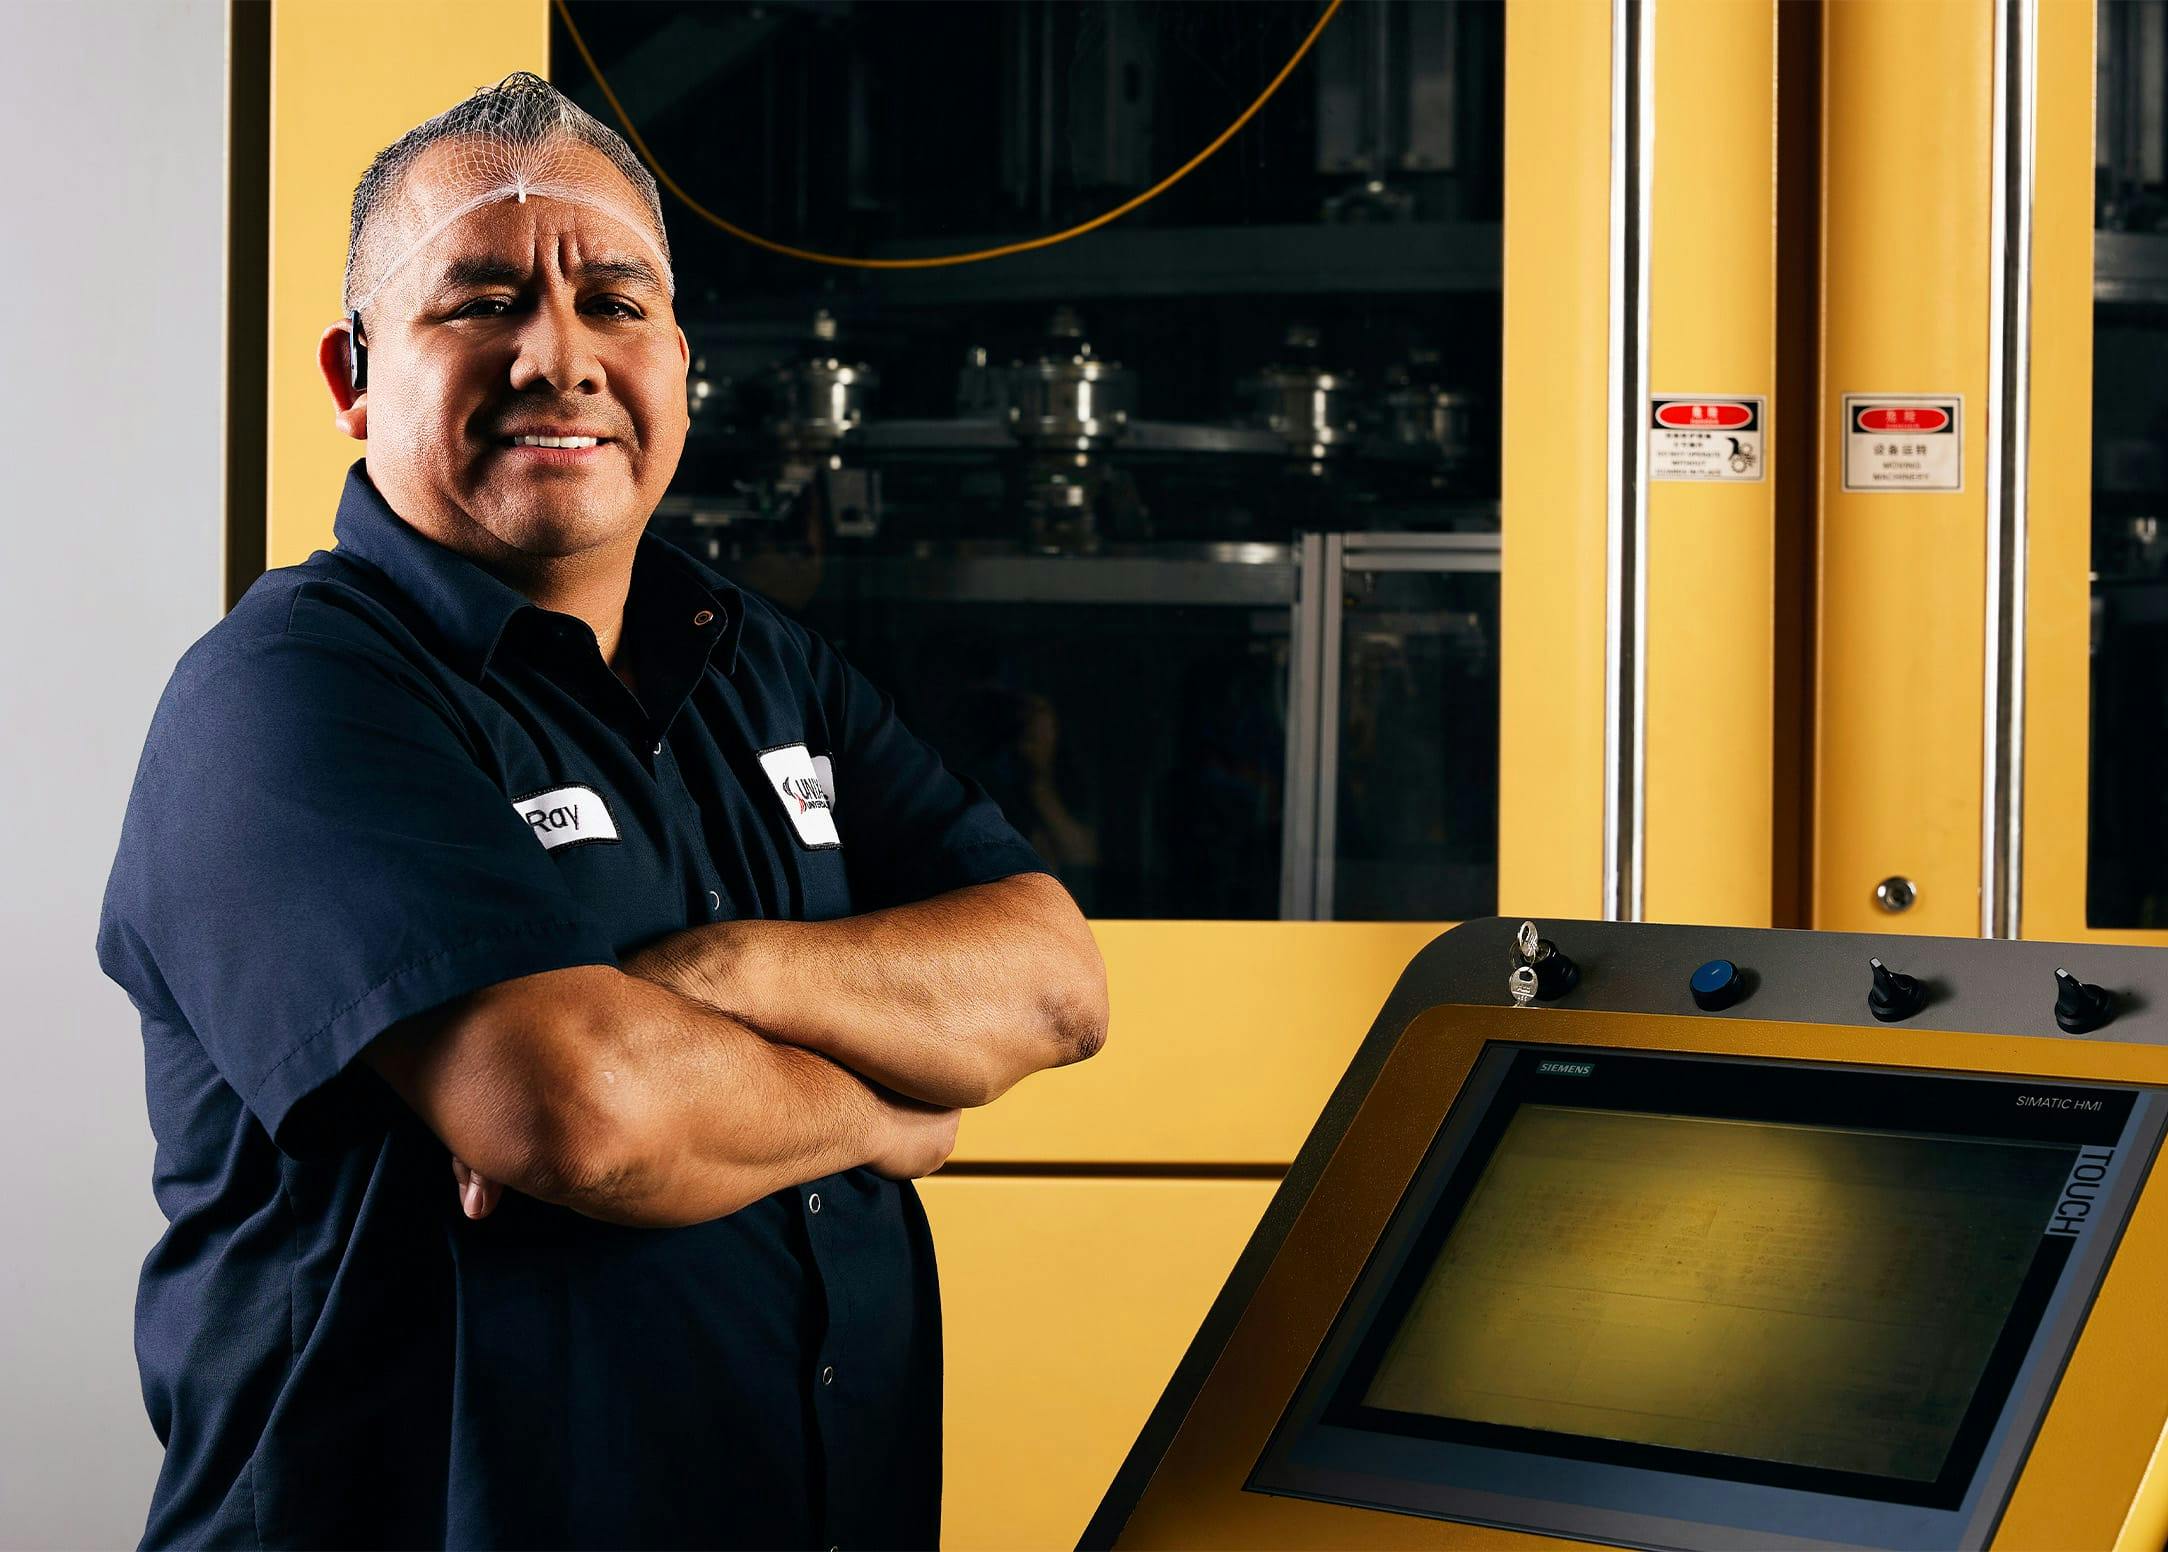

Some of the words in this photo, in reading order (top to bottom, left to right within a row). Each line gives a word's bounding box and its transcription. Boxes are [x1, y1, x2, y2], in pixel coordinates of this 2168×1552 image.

[525, 804, 579, 833] Ray
[1540, 1063, 1591, 1074] SIEMENS
[2016, 1095, 2072, 1110] SIMATIC
[2073, 1100, 2103, 1112] HMI
[2049, 1149, 2115, 1235] TOUCH
